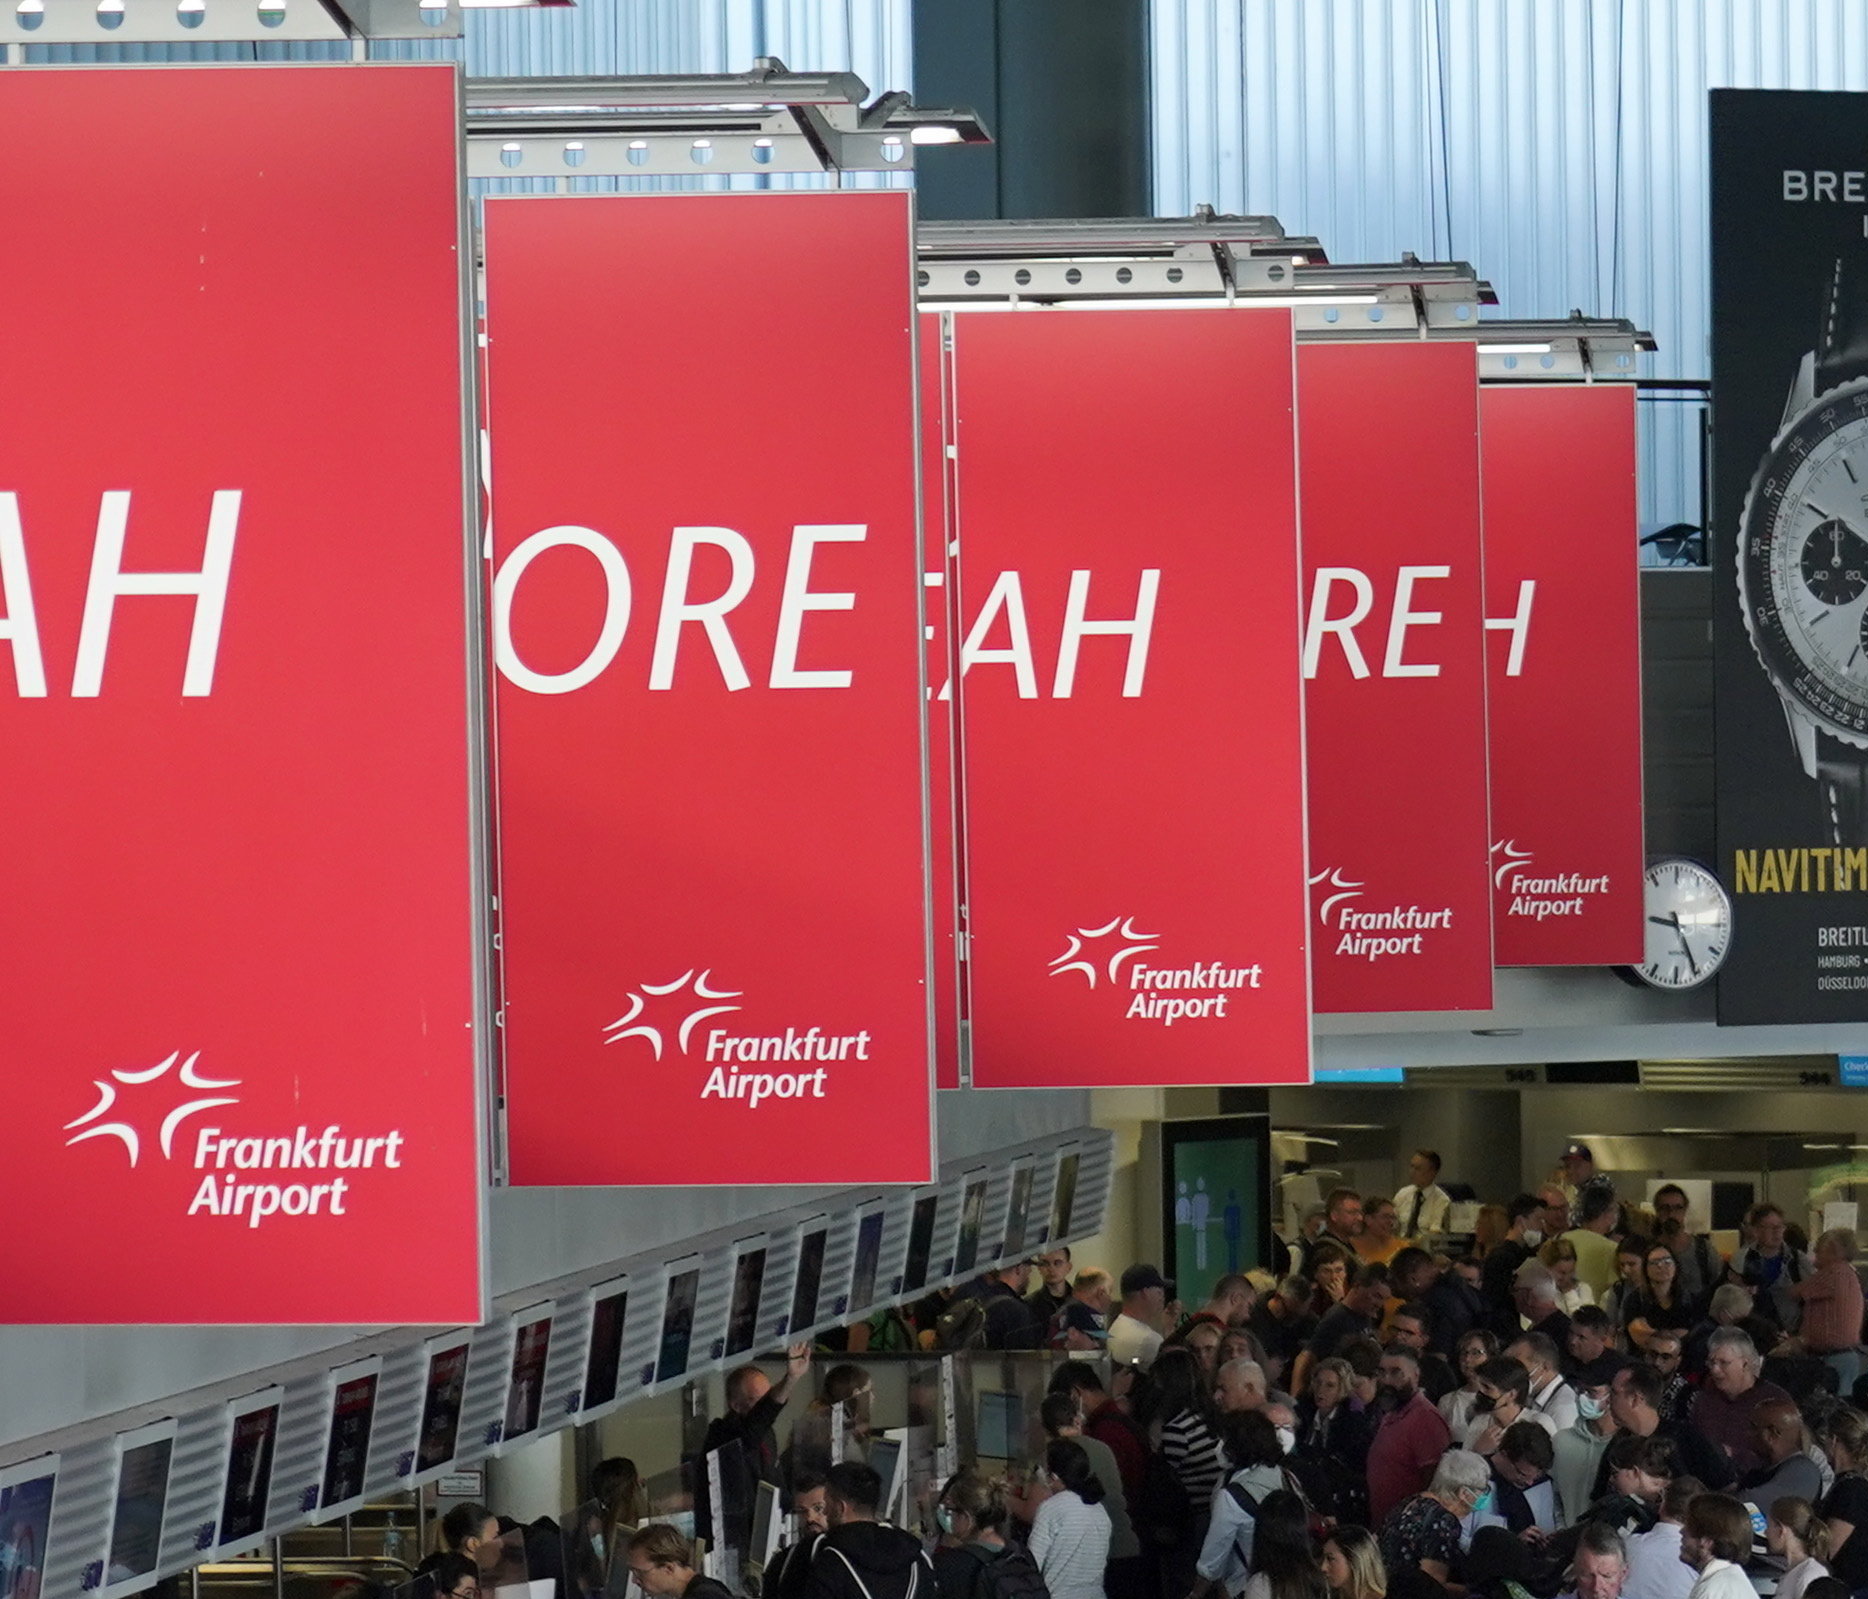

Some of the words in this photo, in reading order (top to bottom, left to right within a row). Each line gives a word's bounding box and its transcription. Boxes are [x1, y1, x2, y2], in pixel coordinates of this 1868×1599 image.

[1512, 873, 1608, 893] Frankfurt
[1340, 906, 1452, 929] Frankfurt
[1509, 896, 1583, 917] Airport
[1336, 933, 1422, 956] Airport
[1818, 955, 1860, 967] HAMBURG
[1131, 962, 1261, 989] Frankfurt
[1126, 993, 1227, 1026] Airport
[706, 1027, 870, 1061] Frankfurt
[701, 1066, 827, 1108] Airport
[195, 1126, 403, 1168] Frankfurt
[188, 1174, 348, 1228] Airport
